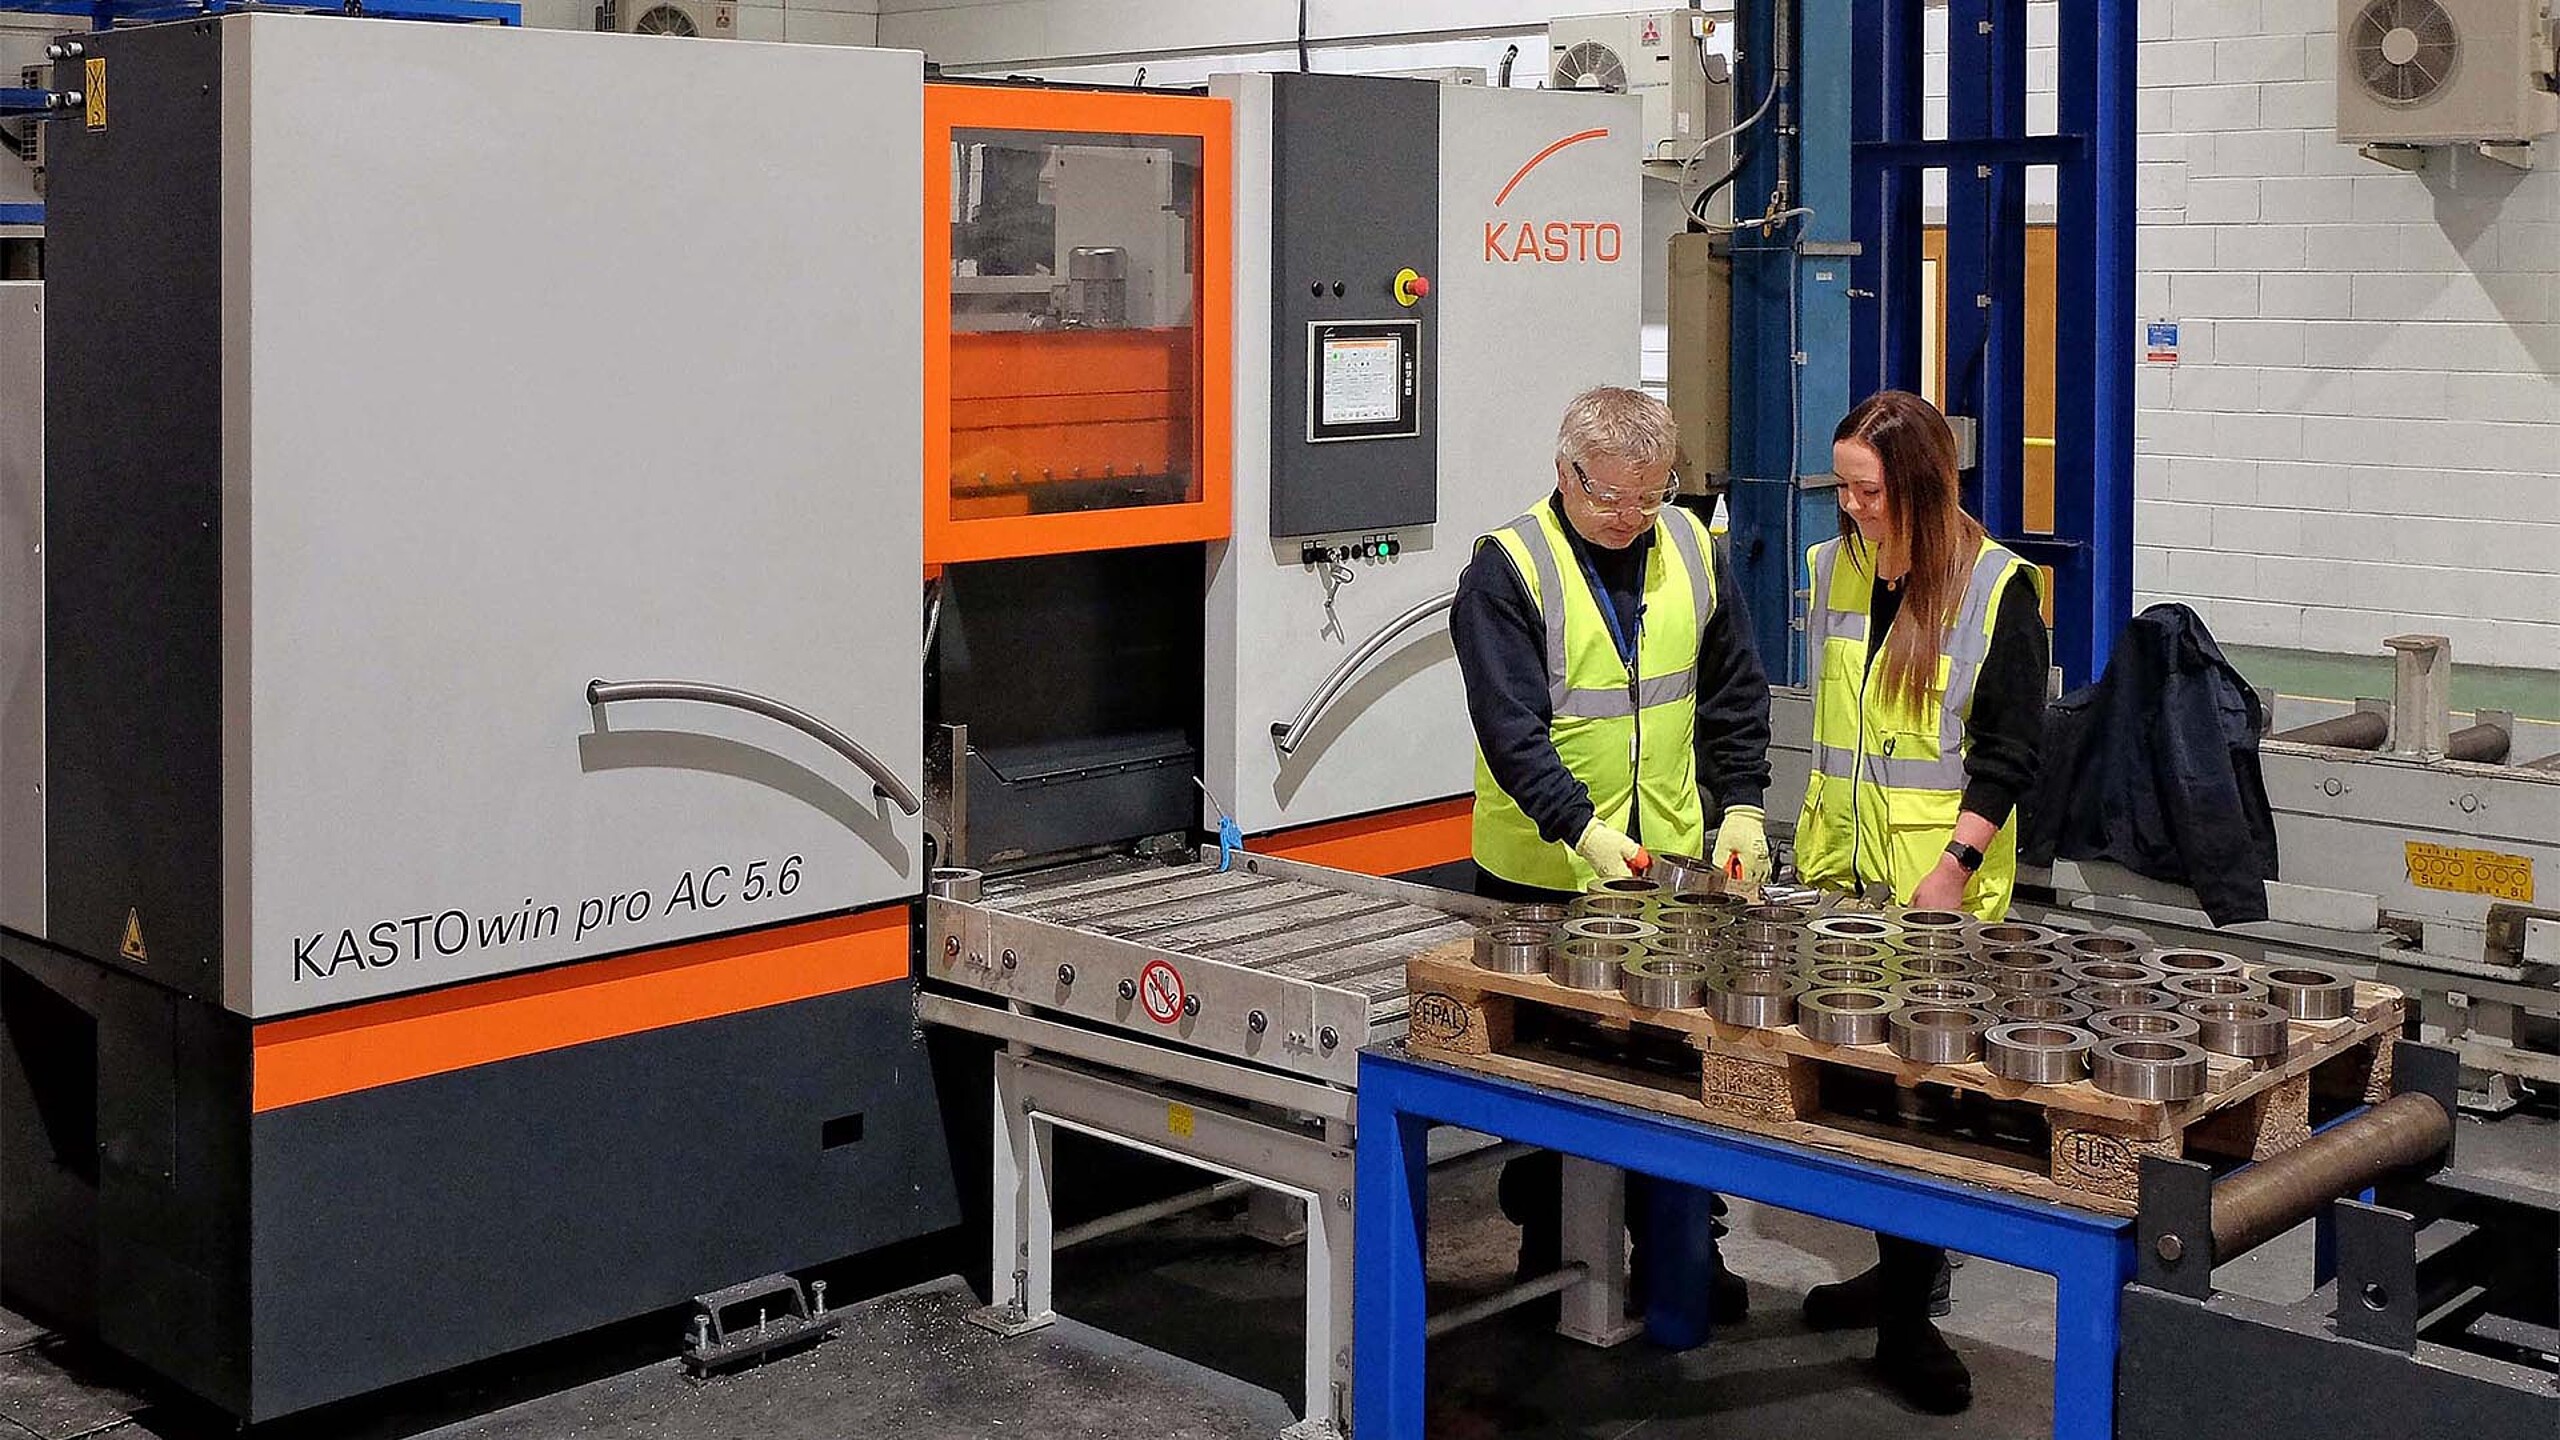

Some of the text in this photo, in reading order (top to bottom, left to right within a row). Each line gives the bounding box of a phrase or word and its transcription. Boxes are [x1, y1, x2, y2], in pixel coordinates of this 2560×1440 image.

[1484, 221, 1622, 263] KASTO
[292, 854, 804, 982] KASTOwin pro AC 5.6
[1422, 1001, 1462, 1031] EPAL
[2075, 1137, 2120, 1169] EUR
